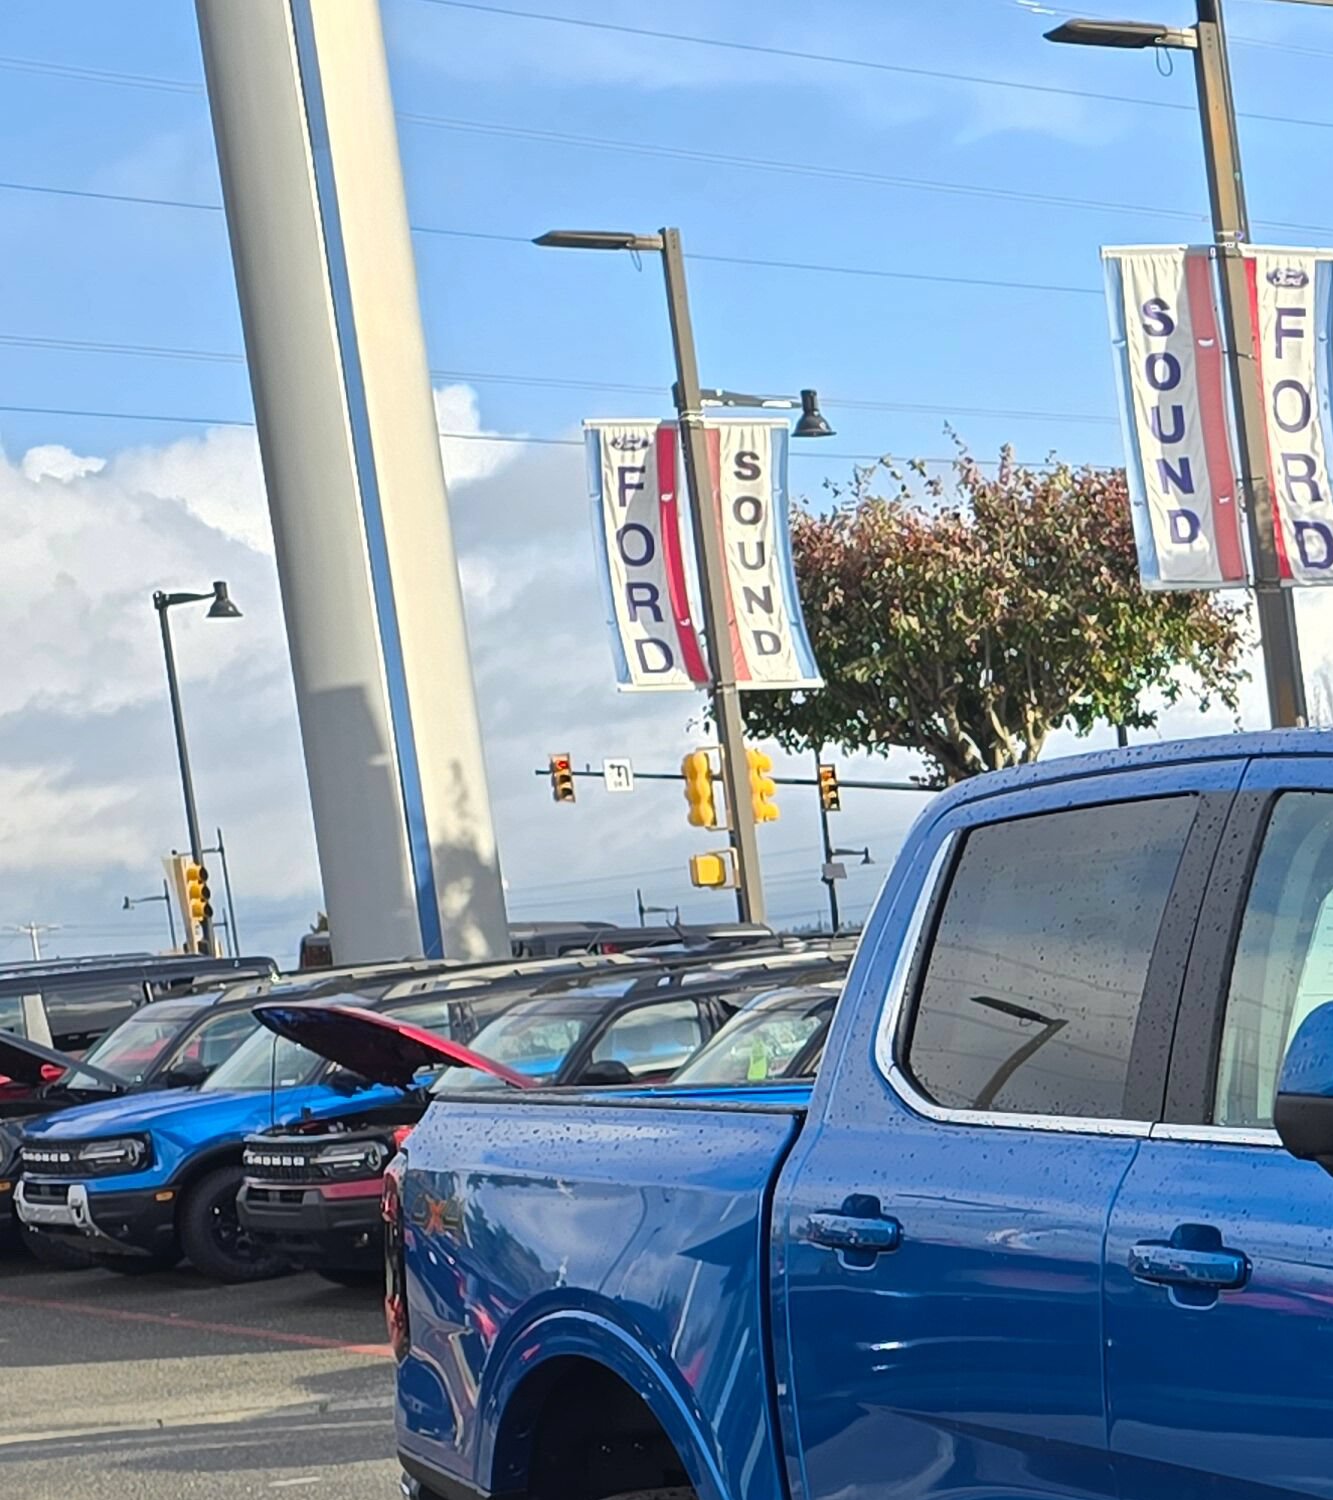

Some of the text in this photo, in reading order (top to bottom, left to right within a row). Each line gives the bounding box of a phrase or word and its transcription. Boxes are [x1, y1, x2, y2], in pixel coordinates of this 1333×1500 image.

[1142, 297, 1200, 544] SOUND
[616, 466, 674, 673] FORD
[732, 451, 782, 655] SOUND
